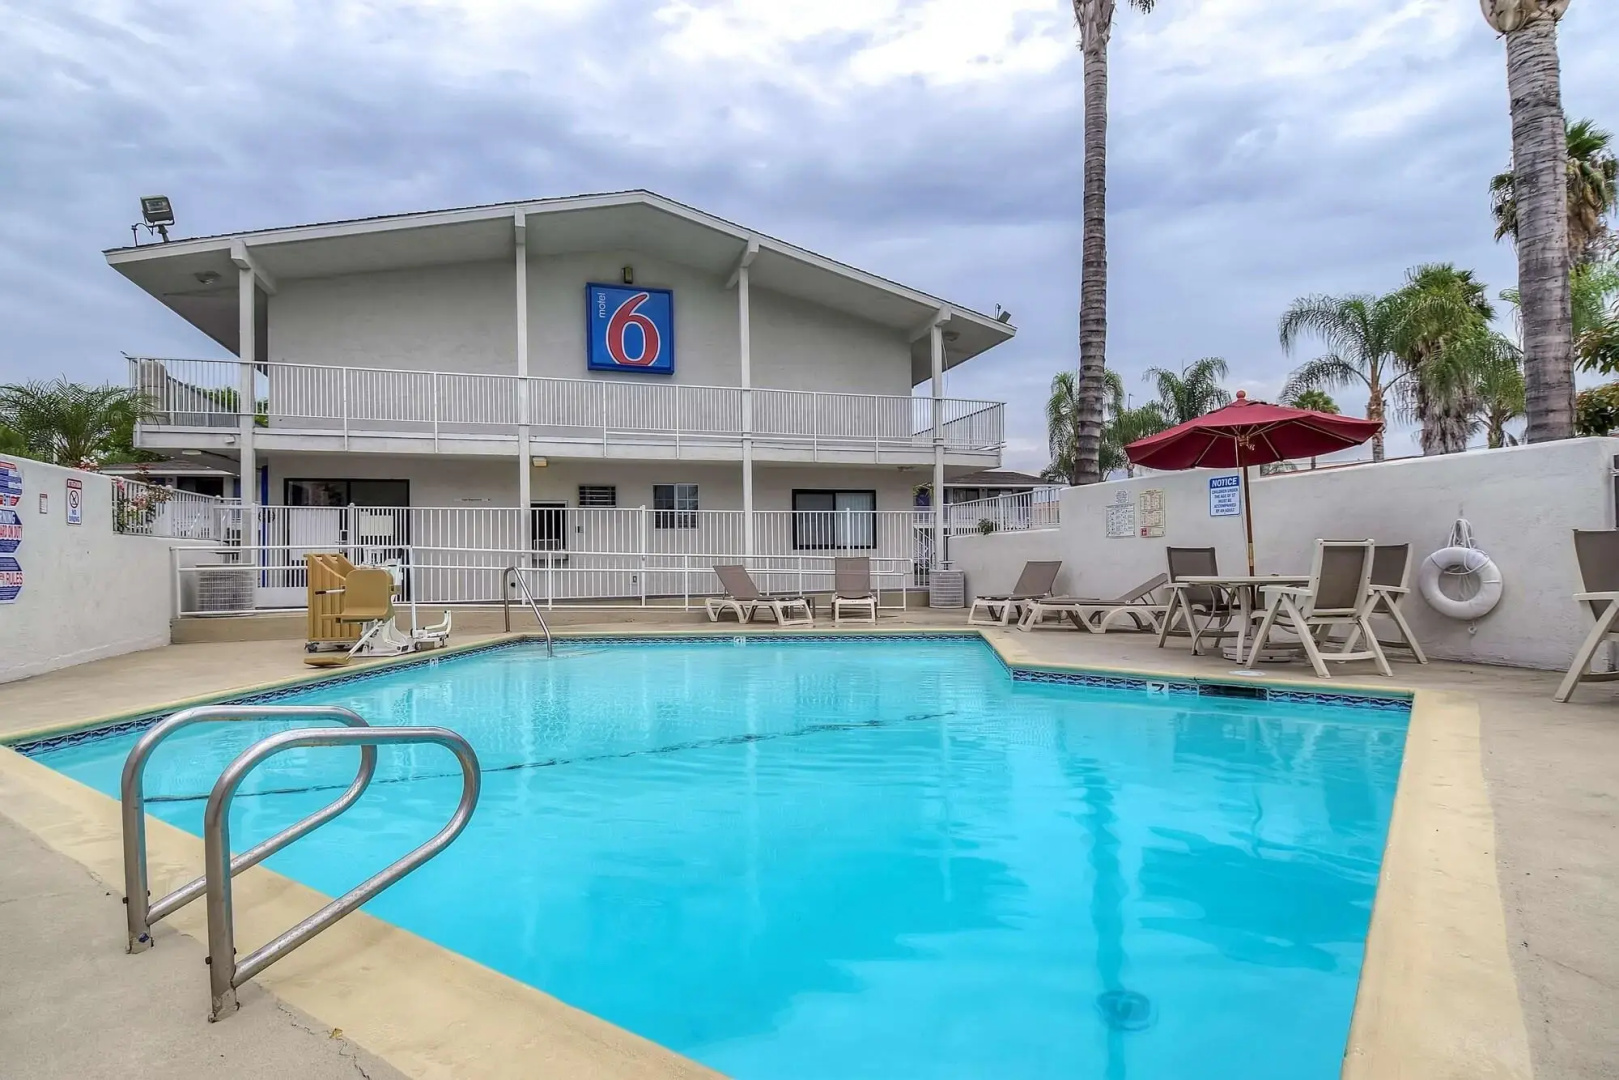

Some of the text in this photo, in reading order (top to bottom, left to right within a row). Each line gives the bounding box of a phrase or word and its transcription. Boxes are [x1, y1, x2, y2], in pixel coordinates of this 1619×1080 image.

[597, 292, 660, 366] motel 6
[1211, 477, 1237, 487] NOTICE
[6, 572, 23, 586] RULES
